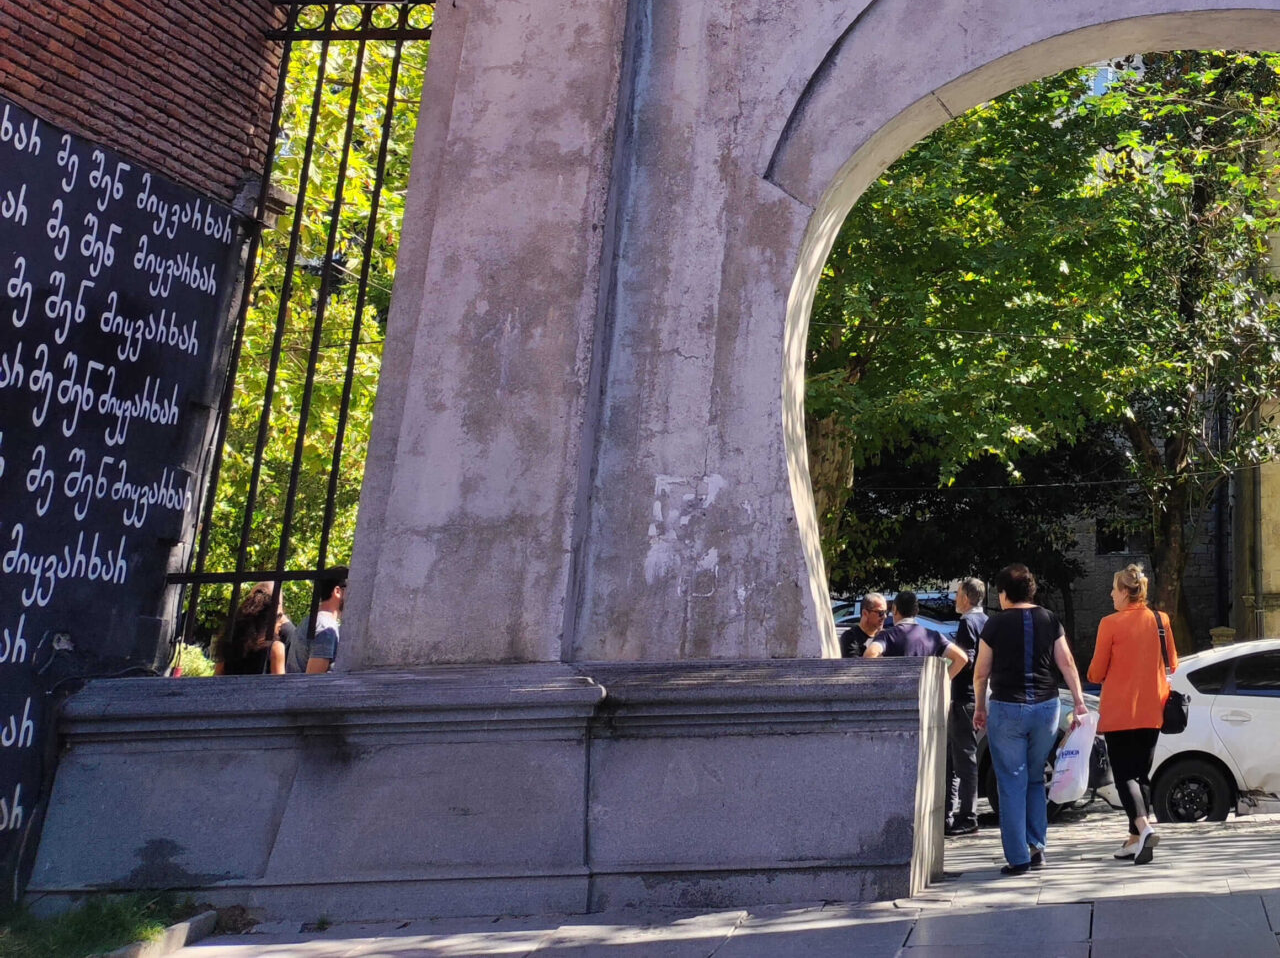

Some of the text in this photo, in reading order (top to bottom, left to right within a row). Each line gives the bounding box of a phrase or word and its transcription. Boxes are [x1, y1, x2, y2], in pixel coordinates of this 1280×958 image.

[56, 134, 79, 193] მე
[88, 149, 131, 212] შენ
[136, 172, 232, 244] მიყვარხარ
[46, 198, 70, 261] მე
[80, 212, 123, 278] შენ
[133, 234, 217, 298] მიყვარხარ
[7, 256, 199, 362] მე შენ მიყვარხარ
[29, 343, 54, 428] მე
[57, 351, 105, 438] შენ
[98, 365, 179, 447] მიყვარხარ
[26, 445, 55, 517] მე
[63, 447, 115, 521] შენ
[111, 459, 192, 529] მიყვარხარ
[2, 522, 127, 607] მიყვარხარ
